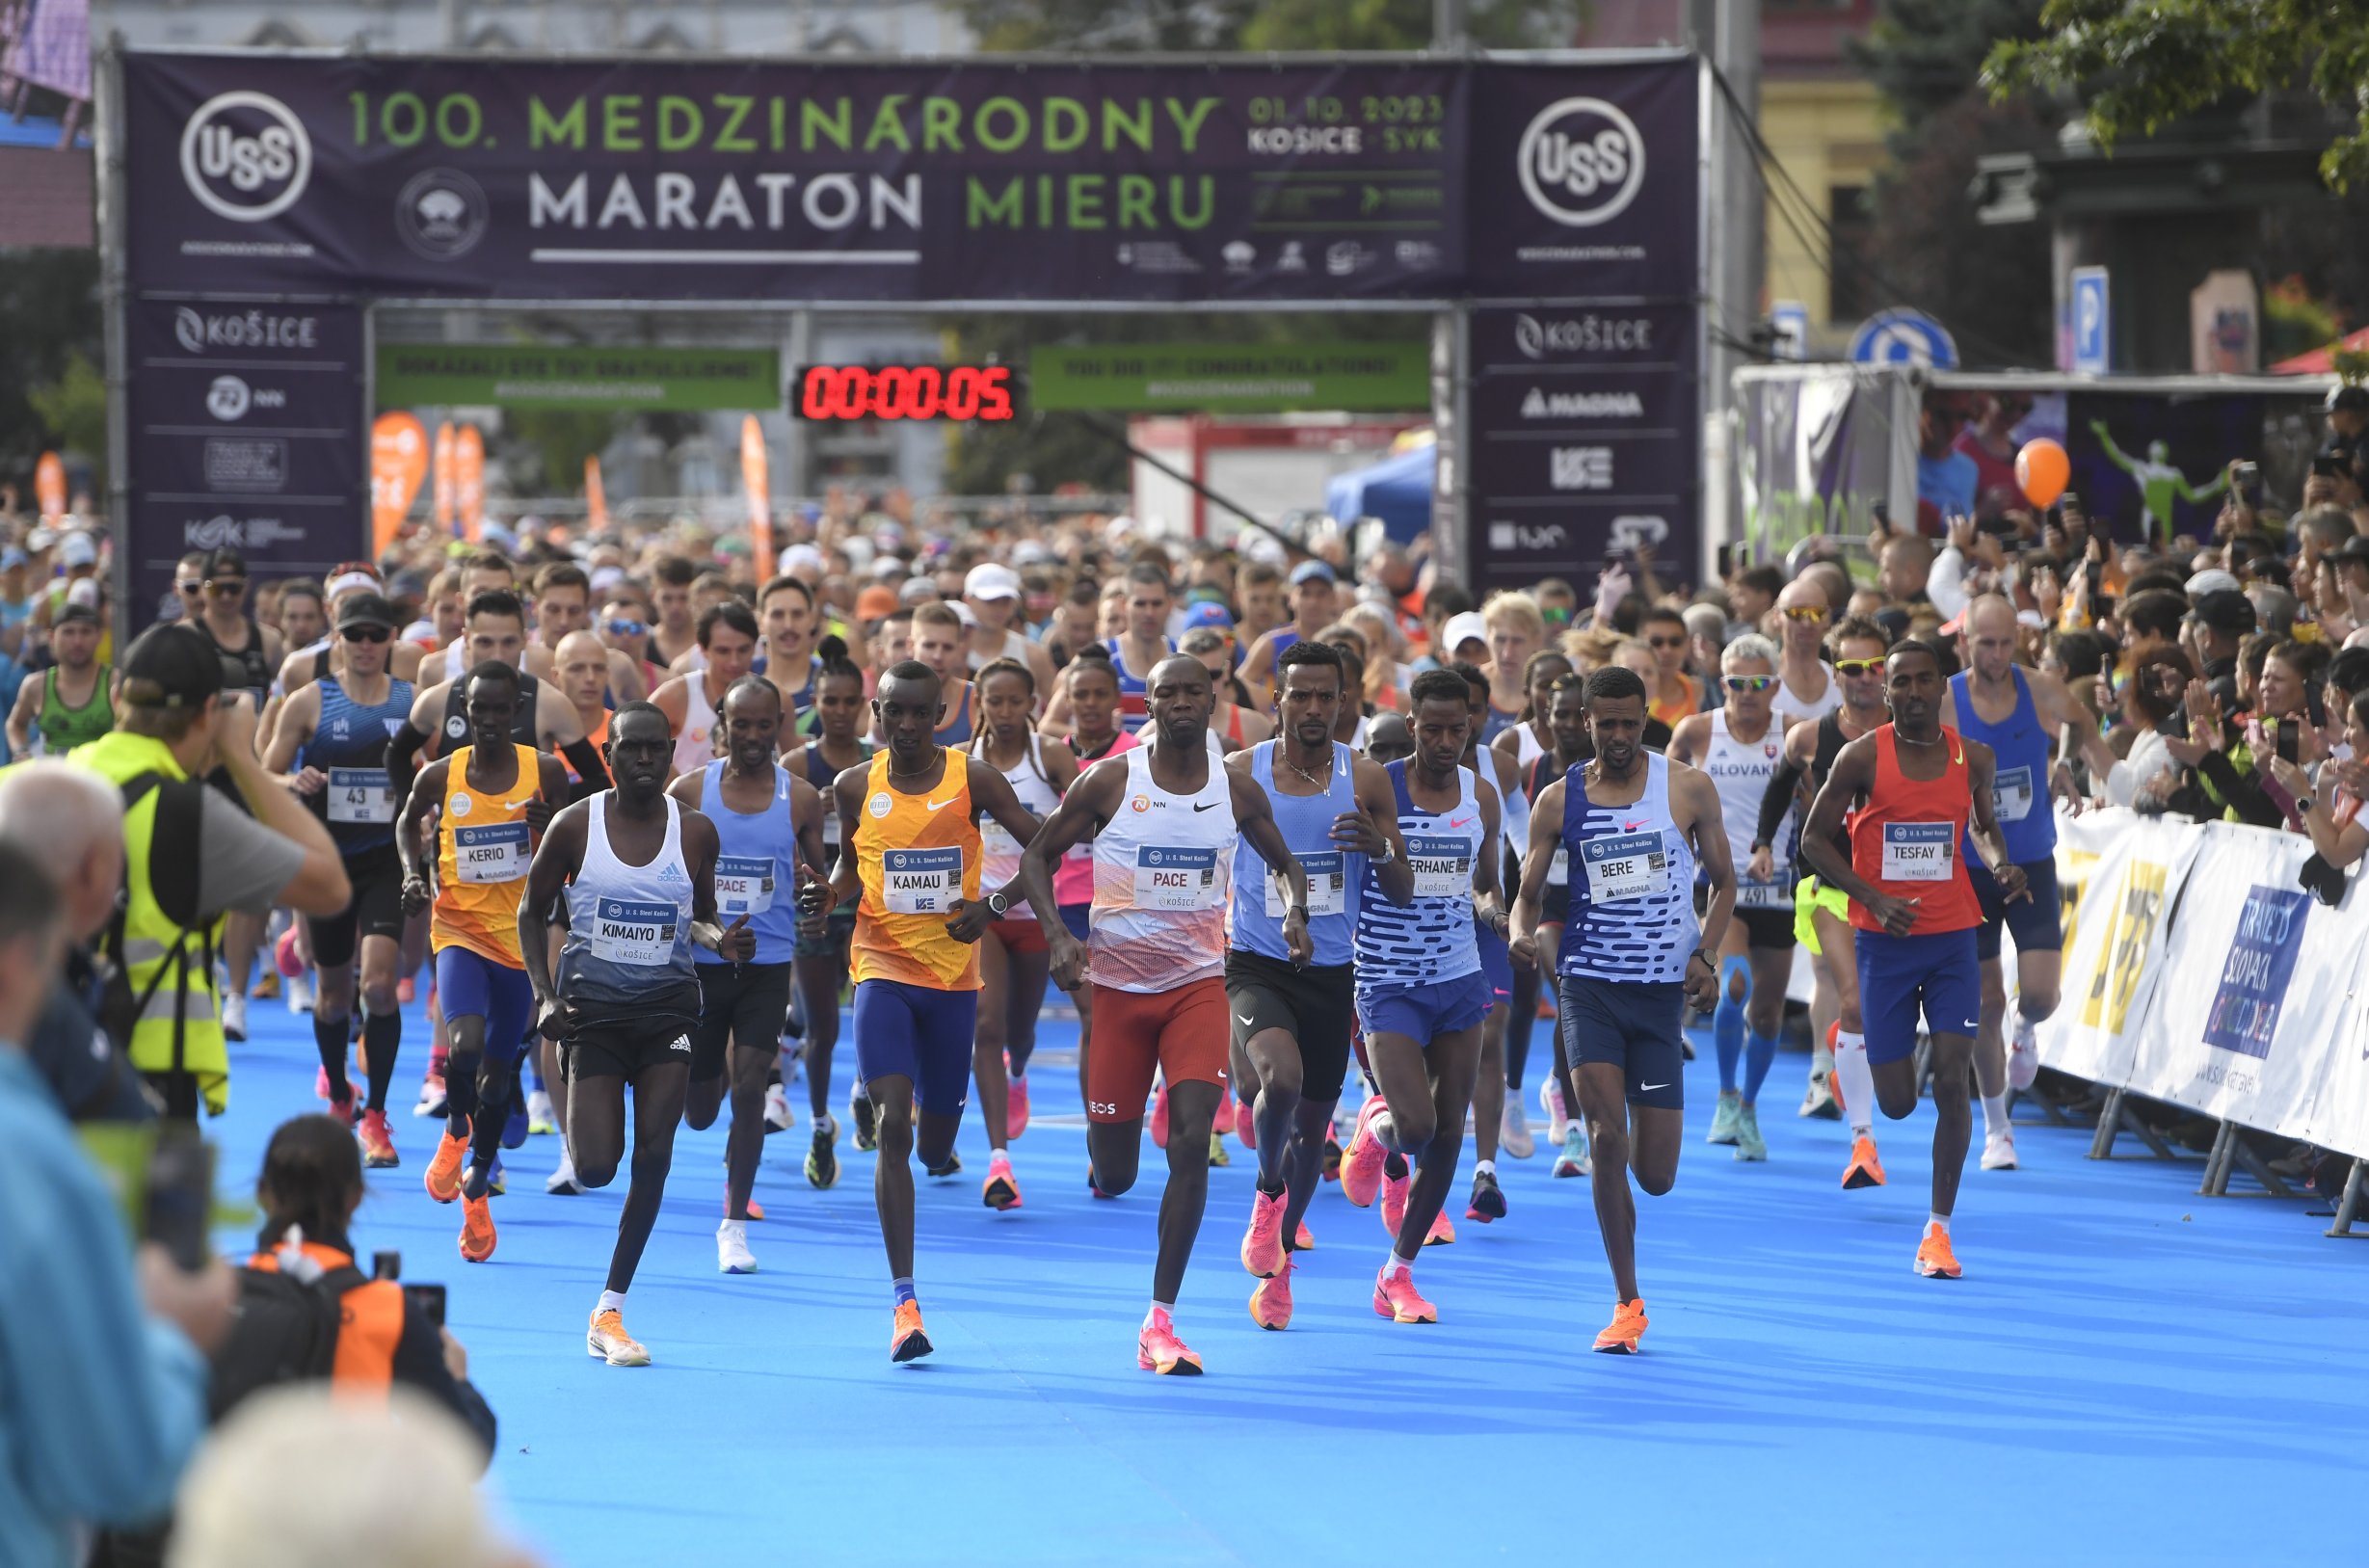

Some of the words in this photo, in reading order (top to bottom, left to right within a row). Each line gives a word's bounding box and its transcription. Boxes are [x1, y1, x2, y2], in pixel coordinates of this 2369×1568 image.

[1361, 94, 1442, 123] 2023
[350, 92, 496, 148] 100.
[200, 125, 294, 192] USS
[1536, 129, 1627, 197] USS
[967, 173, 1214, 229] MIERU
[206, 308, 318, 348] KOŠICE
[1545, 313, 1652, 352] KOŠICE
[1710, 763, 1771, 777] SLOVAK
[346, 787, 366, 804] 43
[468, 847, 504, 863] KERIO
[1893, 846, 1935, 859] TESFAY
[1408, 859, 1455, 873] ERHANE
[1601, 861, 1635, 878] BERE
[485, 869, 518, 879] MAGNA
[657, 873, 684, 883] adidas
[892, 874, 941, 889] KAMAU
[1154, 872, 1188, 887] PACE
[716, 878, 747, 892] PACE
[1424, 883, 1450, 891] KOŠICE
[1615, 884, 1651, 896] MAGNA
[1166, 896, 1196, 906] KOŠICE
[1744, 887, 1768, 903] 491
[1306, 904, 1330, 913] AGNA
[601, 922, 655, 942] KIMAIYO
[623, 949, 653, 960] KOŠICE
[1089, 1102, 1116, 1115] EOS
